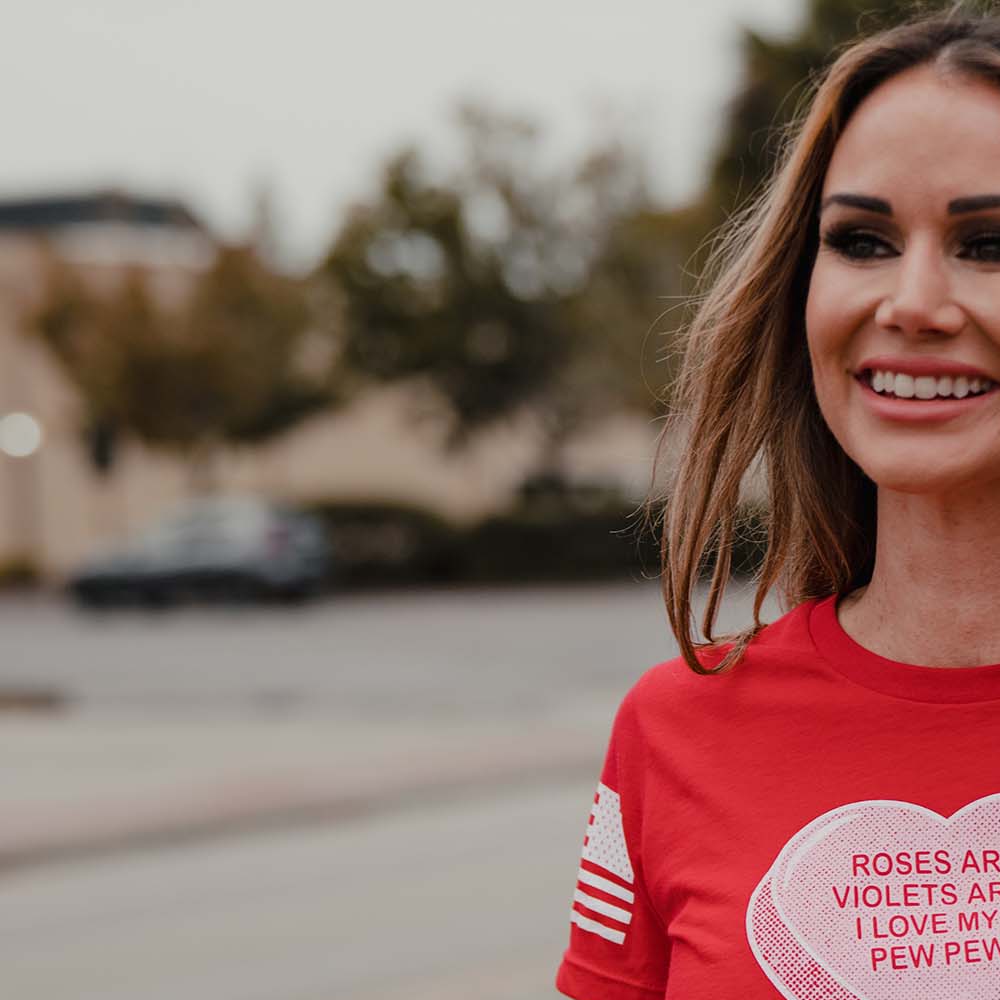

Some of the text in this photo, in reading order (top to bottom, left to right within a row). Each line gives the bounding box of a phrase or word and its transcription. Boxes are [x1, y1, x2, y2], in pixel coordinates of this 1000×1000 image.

[852, 849, 951, 876] ROSES
[832, 883, 958, 909] VIOLETS
[855, 917, 862, 940] I
[872, 913, 949, 939] LOVE
[958, 910, 998, 932] MY
[871, 944, 935, 972] PEW
